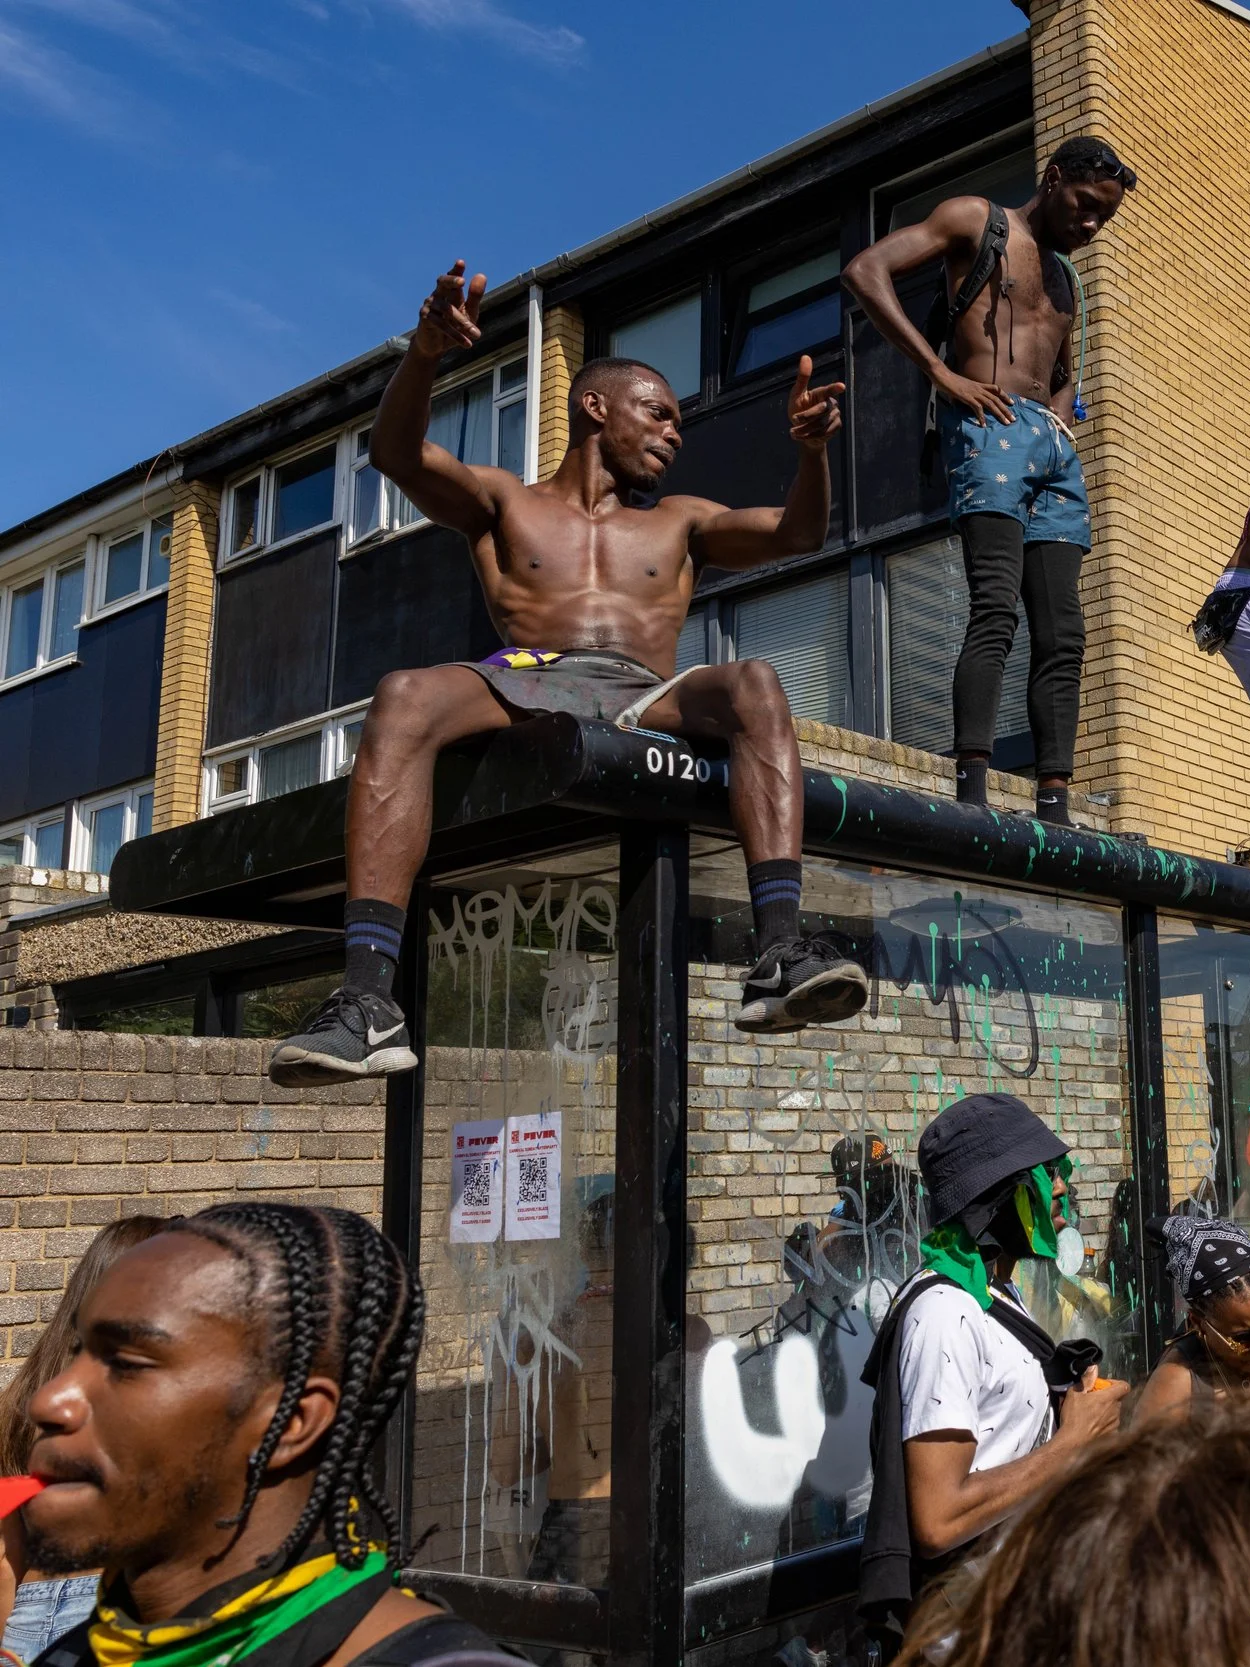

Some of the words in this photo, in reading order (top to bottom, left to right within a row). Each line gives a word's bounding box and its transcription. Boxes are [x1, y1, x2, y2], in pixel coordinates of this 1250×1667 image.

[646, 746, 711, 783] 0120
[523, 1129, 556, 1141] FEVER
[468, 1136, 498, 1147] FEVER
